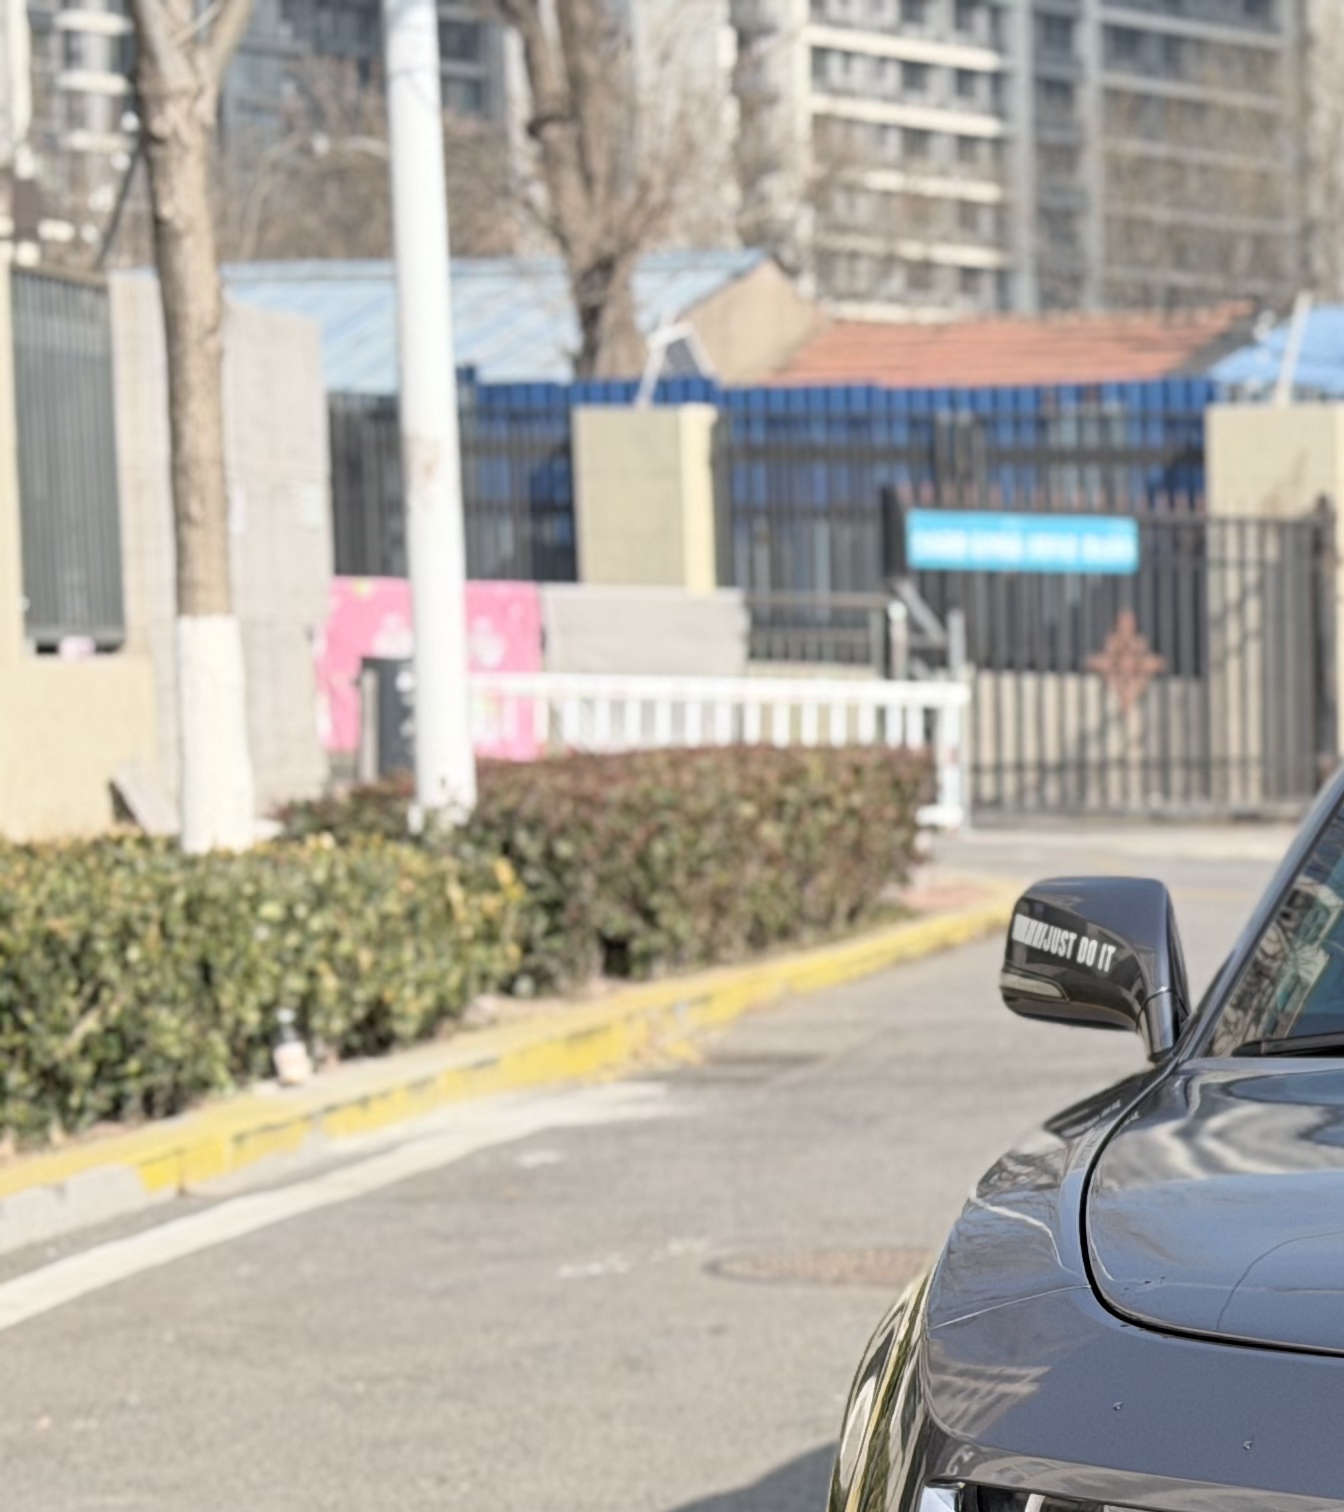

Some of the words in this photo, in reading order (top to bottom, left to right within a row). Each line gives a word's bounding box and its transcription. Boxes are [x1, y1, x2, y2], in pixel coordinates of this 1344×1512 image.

[1043, 926, 1078, 960] JUST
[1076, 936, 1099, 967] DO
[1097, 943, 1117, 973] IT
